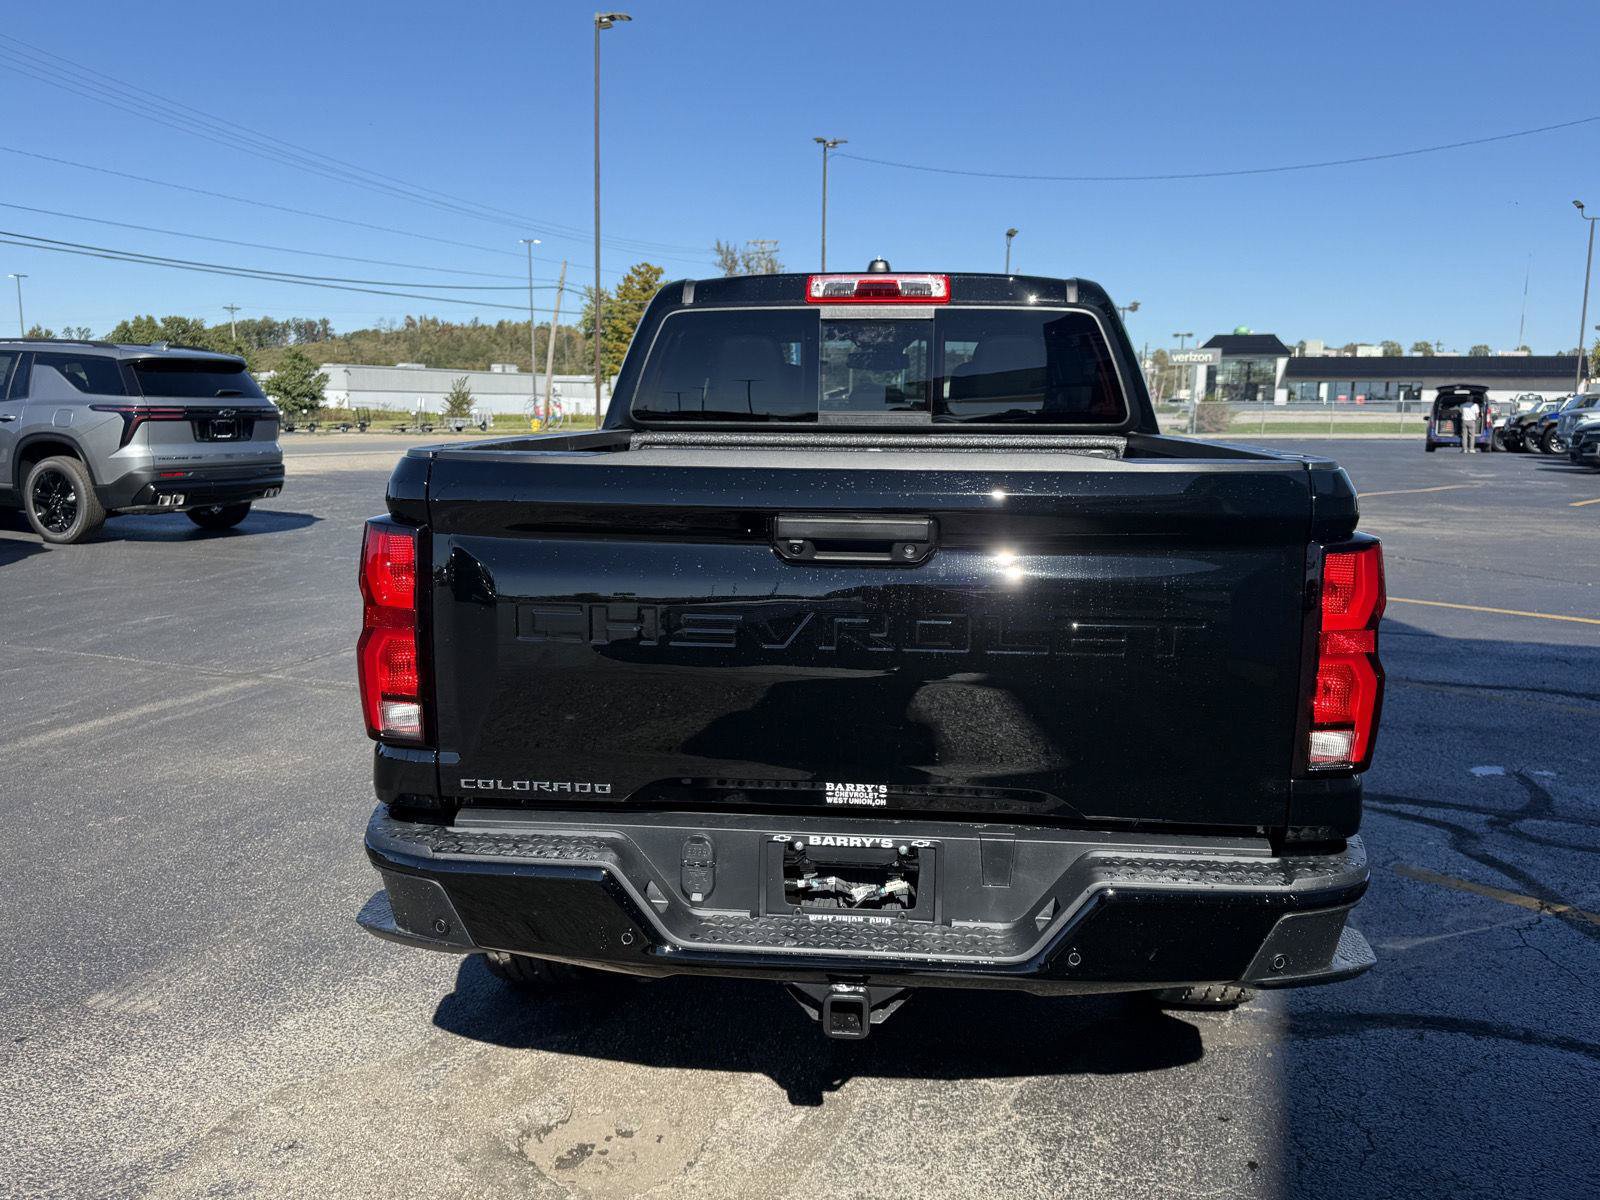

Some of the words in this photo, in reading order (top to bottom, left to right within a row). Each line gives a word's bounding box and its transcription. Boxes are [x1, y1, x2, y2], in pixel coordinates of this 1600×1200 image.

[1171, 350, 1213, 362] verizon
[514, 600, 1208, 659] CHEVROLET
[460, 778, 612, 794] COLORADO
[825, 782, 888, 793] BARRY'S
[826, 796, 848, 804] WEST
[834, 791, 879, 799] CHEVROLET
[808, 835, 894, 848] BARRY'S
